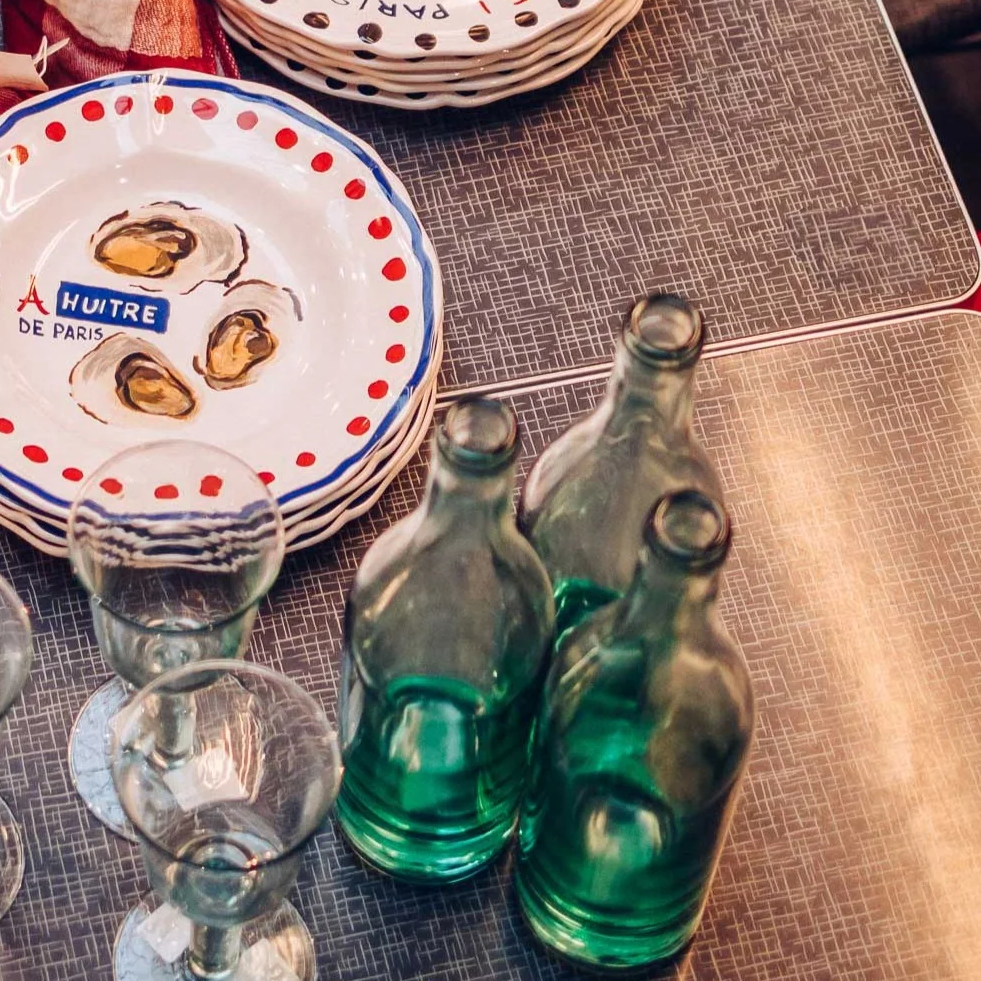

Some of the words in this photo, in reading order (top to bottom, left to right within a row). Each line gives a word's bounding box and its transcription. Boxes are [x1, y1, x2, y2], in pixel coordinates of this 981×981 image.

[61, 291, 159, 324] HUITRE
[19, 317, 44, 337] DE
[53, 322, 103, 341] PARIS
